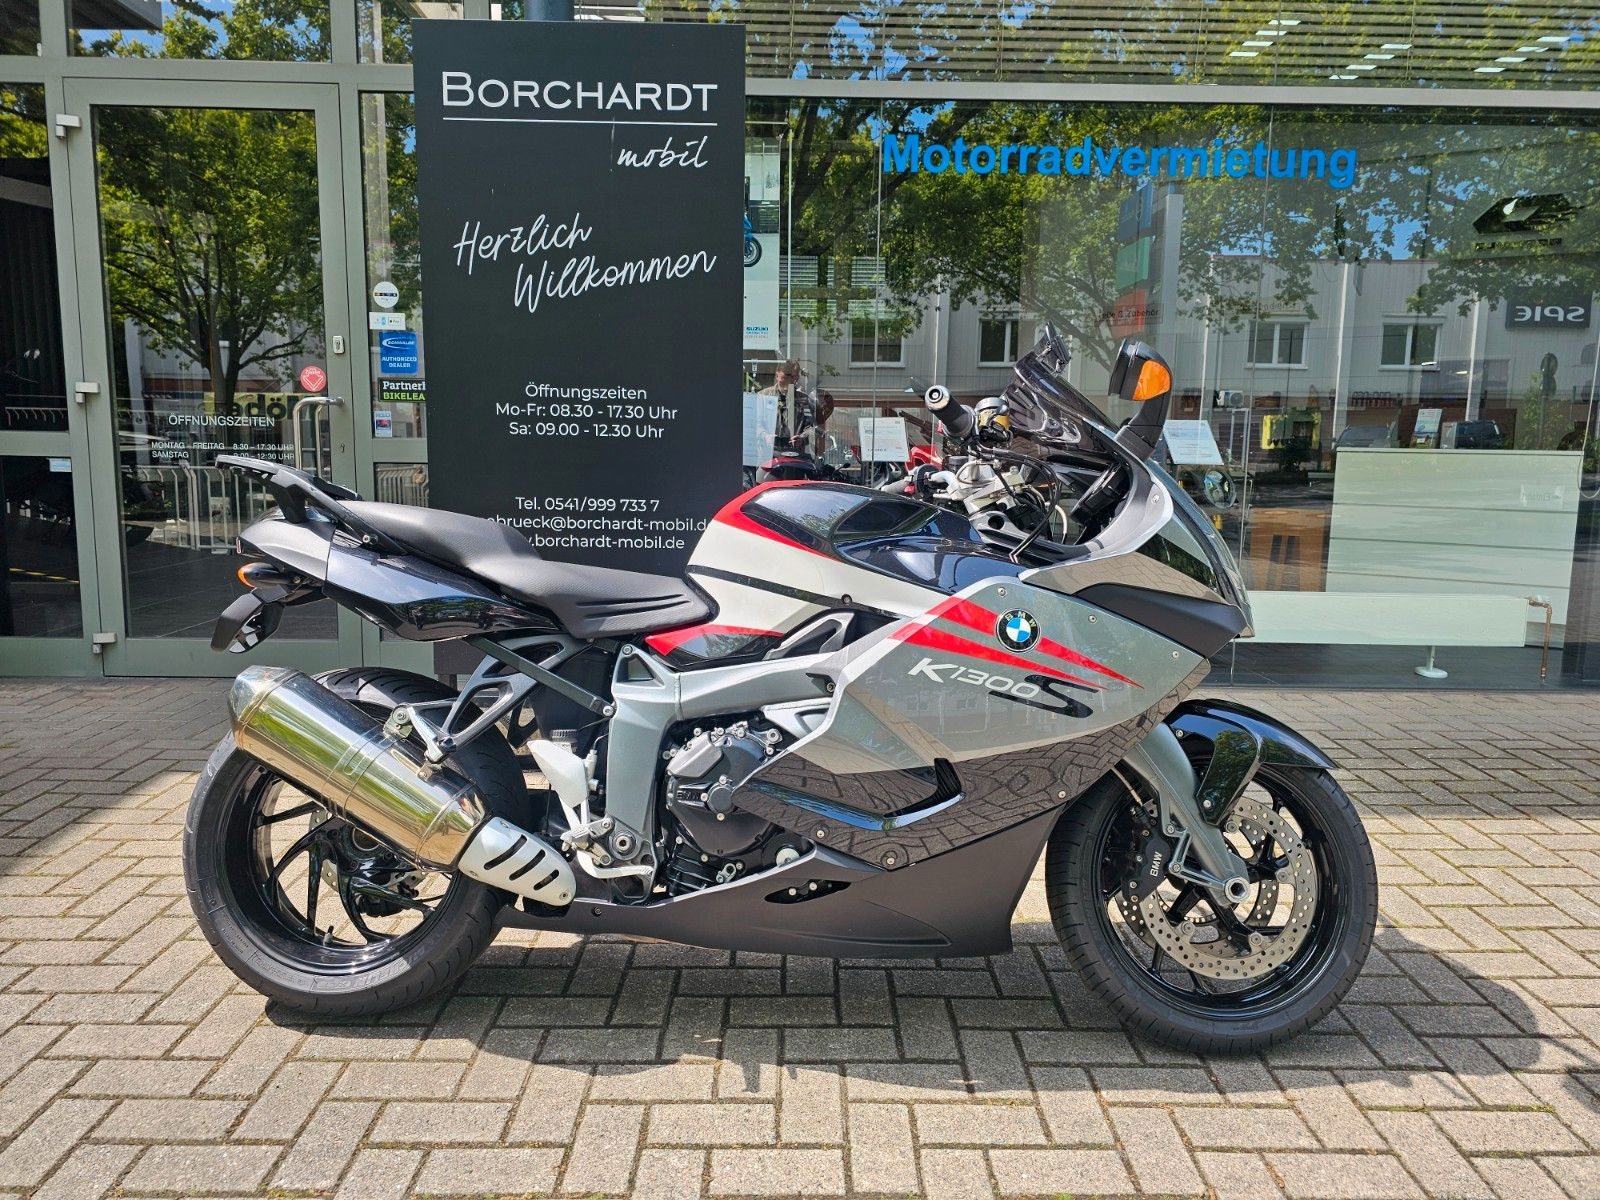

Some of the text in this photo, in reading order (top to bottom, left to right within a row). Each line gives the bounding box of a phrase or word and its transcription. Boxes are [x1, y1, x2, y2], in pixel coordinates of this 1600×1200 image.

[441, 71, 718, 112] BORCHARDT
[616, 136, 709, 169] mobil
[882, 134, 1358, 190] Motorradvermietung
[452, 212, 593, 275] Herzlich
[513, 249, 717, 314] Willkommen
[524, 382, 647, 401] Öffnungszeiten
[168, 413, 275, 427] ÖFFNUNGSZEITEN
[495, 403, 546, 416] Mo-Fr:
[550, 404, 594, 418] 08.30
[607, 405, 644, 419] 17.30
[649, 406, 679, 420] Uhr
[508, 422, 531, 436] Sa:
[535, 423, 579, 436] 09.00
[593, 424, 631, 438] 12.30
[635, 425, 665, 439] Uhr
[152, 451, 189, 459] SAMSTAG
[232, 443, 249, 451] 8:30
[515, 497, 541, 510] Tel.
[544, 497, 616, 512] 0541/999
[487, 514, 708, 532] brueck@borchardt-mobil.d
[1004, 611, 1037, 628] BMW
[1150, 851, 1163, 877] BMW
